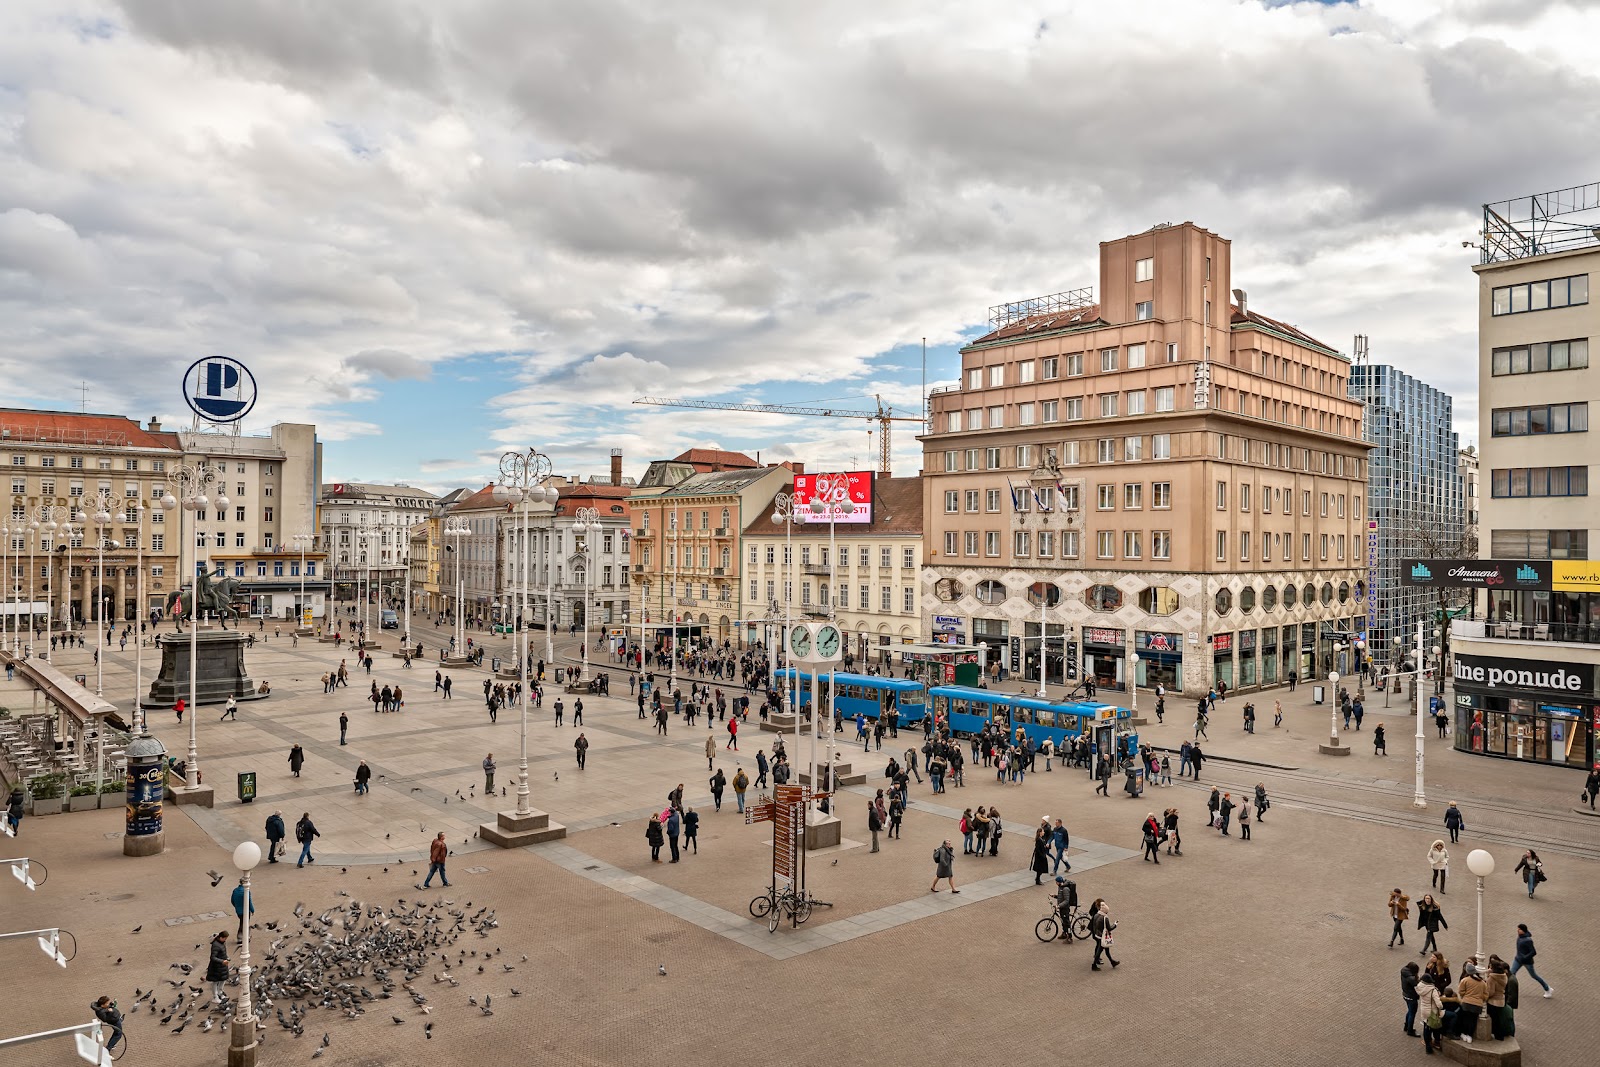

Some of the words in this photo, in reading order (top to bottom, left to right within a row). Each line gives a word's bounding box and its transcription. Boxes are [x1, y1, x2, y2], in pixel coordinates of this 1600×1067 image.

[1368, 534, 1377, 566] HOTEL
[1447, 565, 1499, 578] Amarena
[1368, 569, 1377, 628] DUBROVNIK
[1487, 668, 1582, 691] ponude
